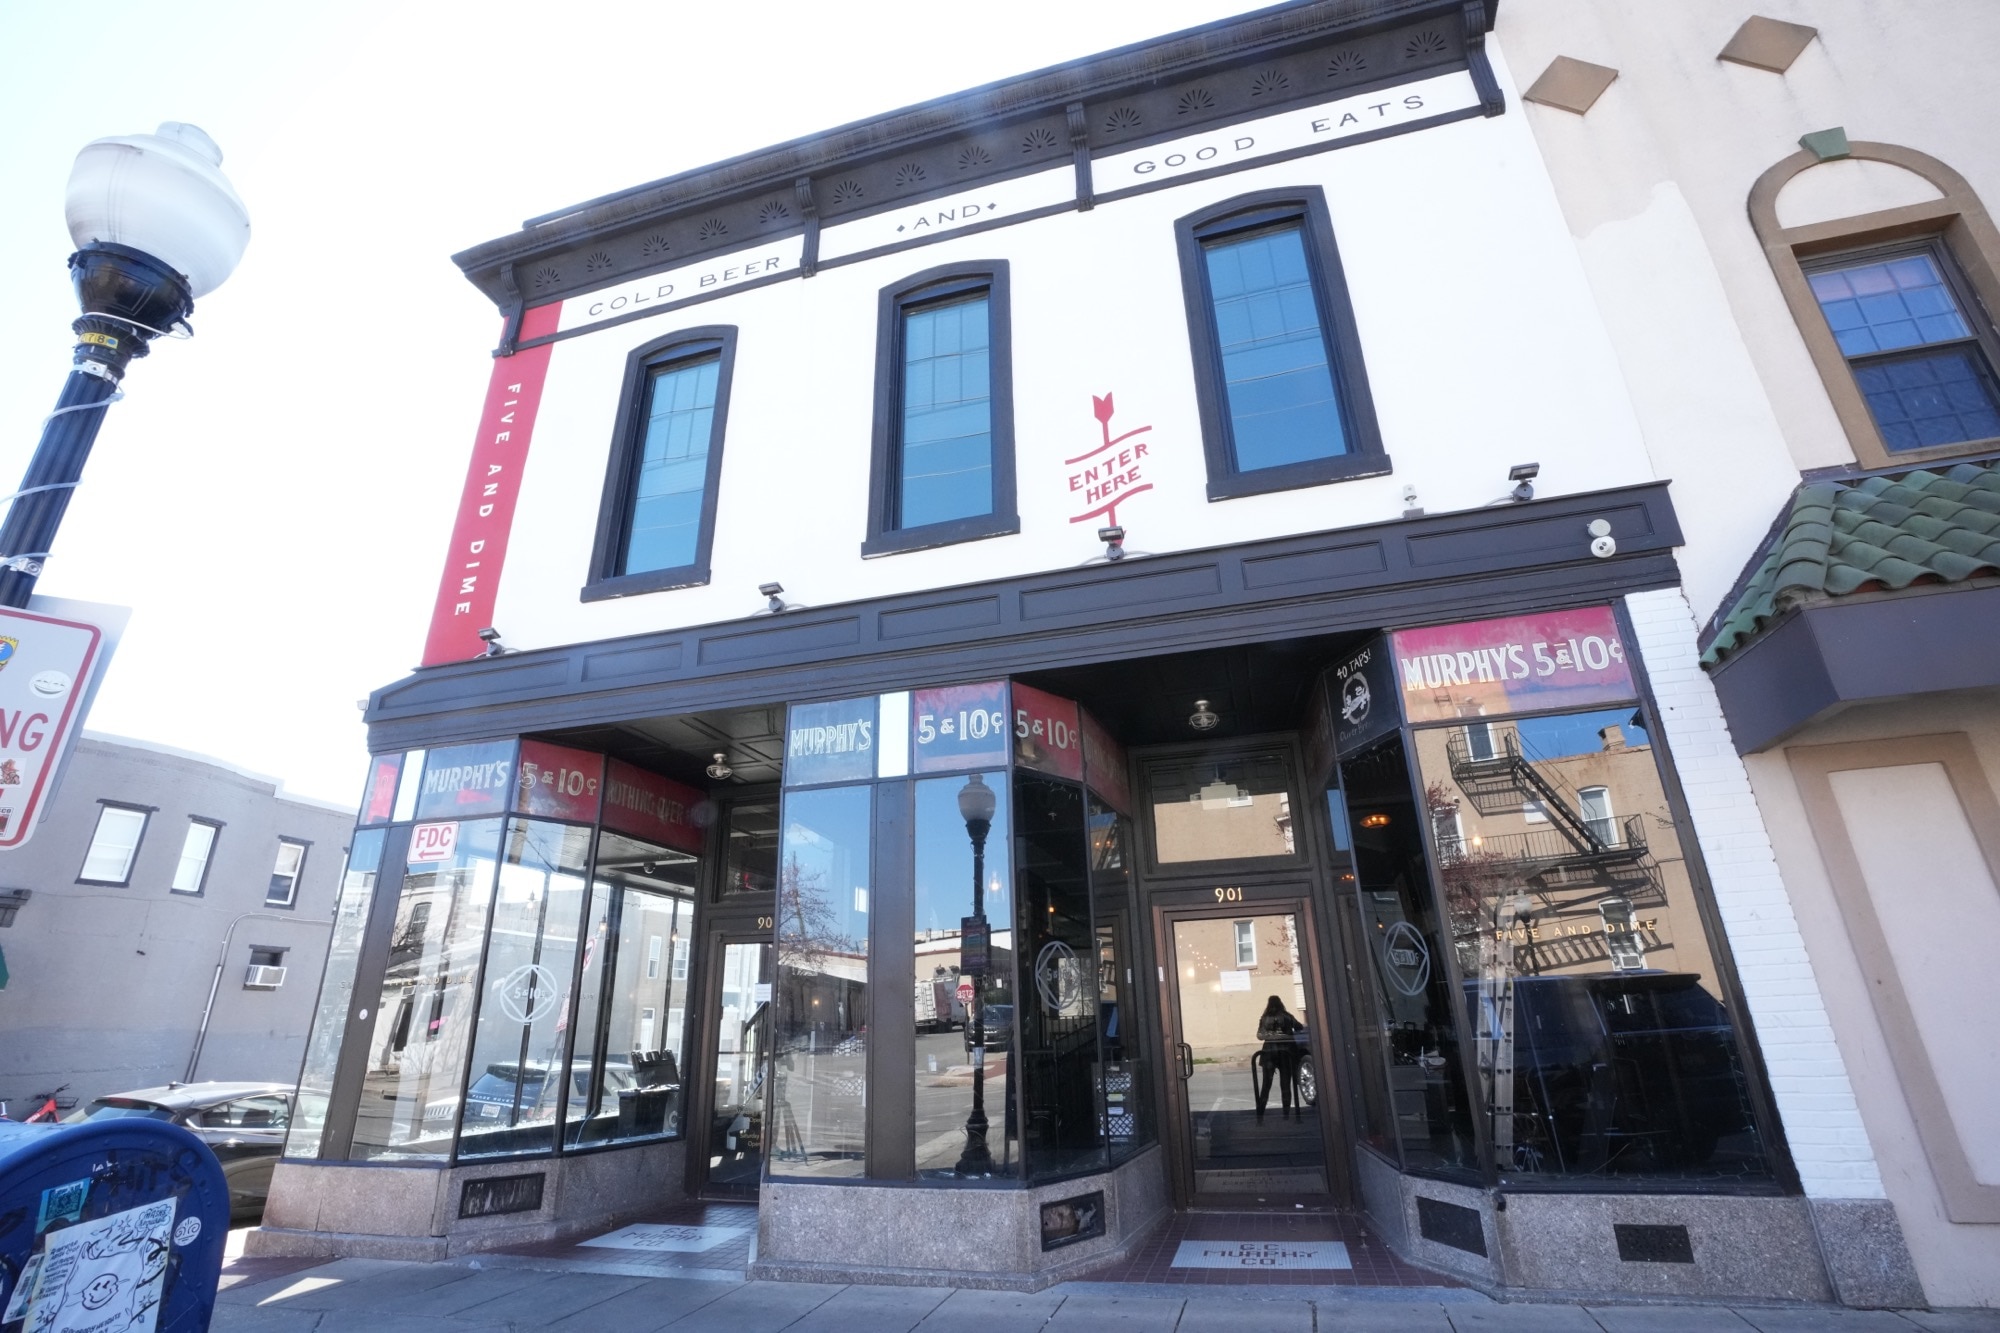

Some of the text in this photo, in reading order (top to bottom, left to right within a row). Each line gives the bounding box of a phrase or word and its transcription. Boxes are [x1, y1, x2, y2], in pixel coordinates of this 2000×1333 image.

[1133, 95, 1425, 175] GOOD EATS
[913, 204, 982, 231] AND
[588, 256, 780, 317] COLD BEER
[1068, 443, 1149, 493] ENTER
[454, 382, 521, 617] FIVE AND DIME
[1085, 466, 1142, 506] HERE
[1336, 647, 1372, 680] 40 TAPS!
[1401, 643, 1530, 692] MURPHY'S
[789, 718, 872, 757] MURPHY'S
[424, 761, 510, 795] MURPHY'S
[606, 779, 655, 816] NOTHING
[416, 826, 453, 848] FDC
[1214, 887, 1242, 903] 901
[757, 917, 773, 929] 90
[1496, 920, 1657, 941] FIVE AND DIME
[1203, 1250, 1318, 1258] MURPHY
